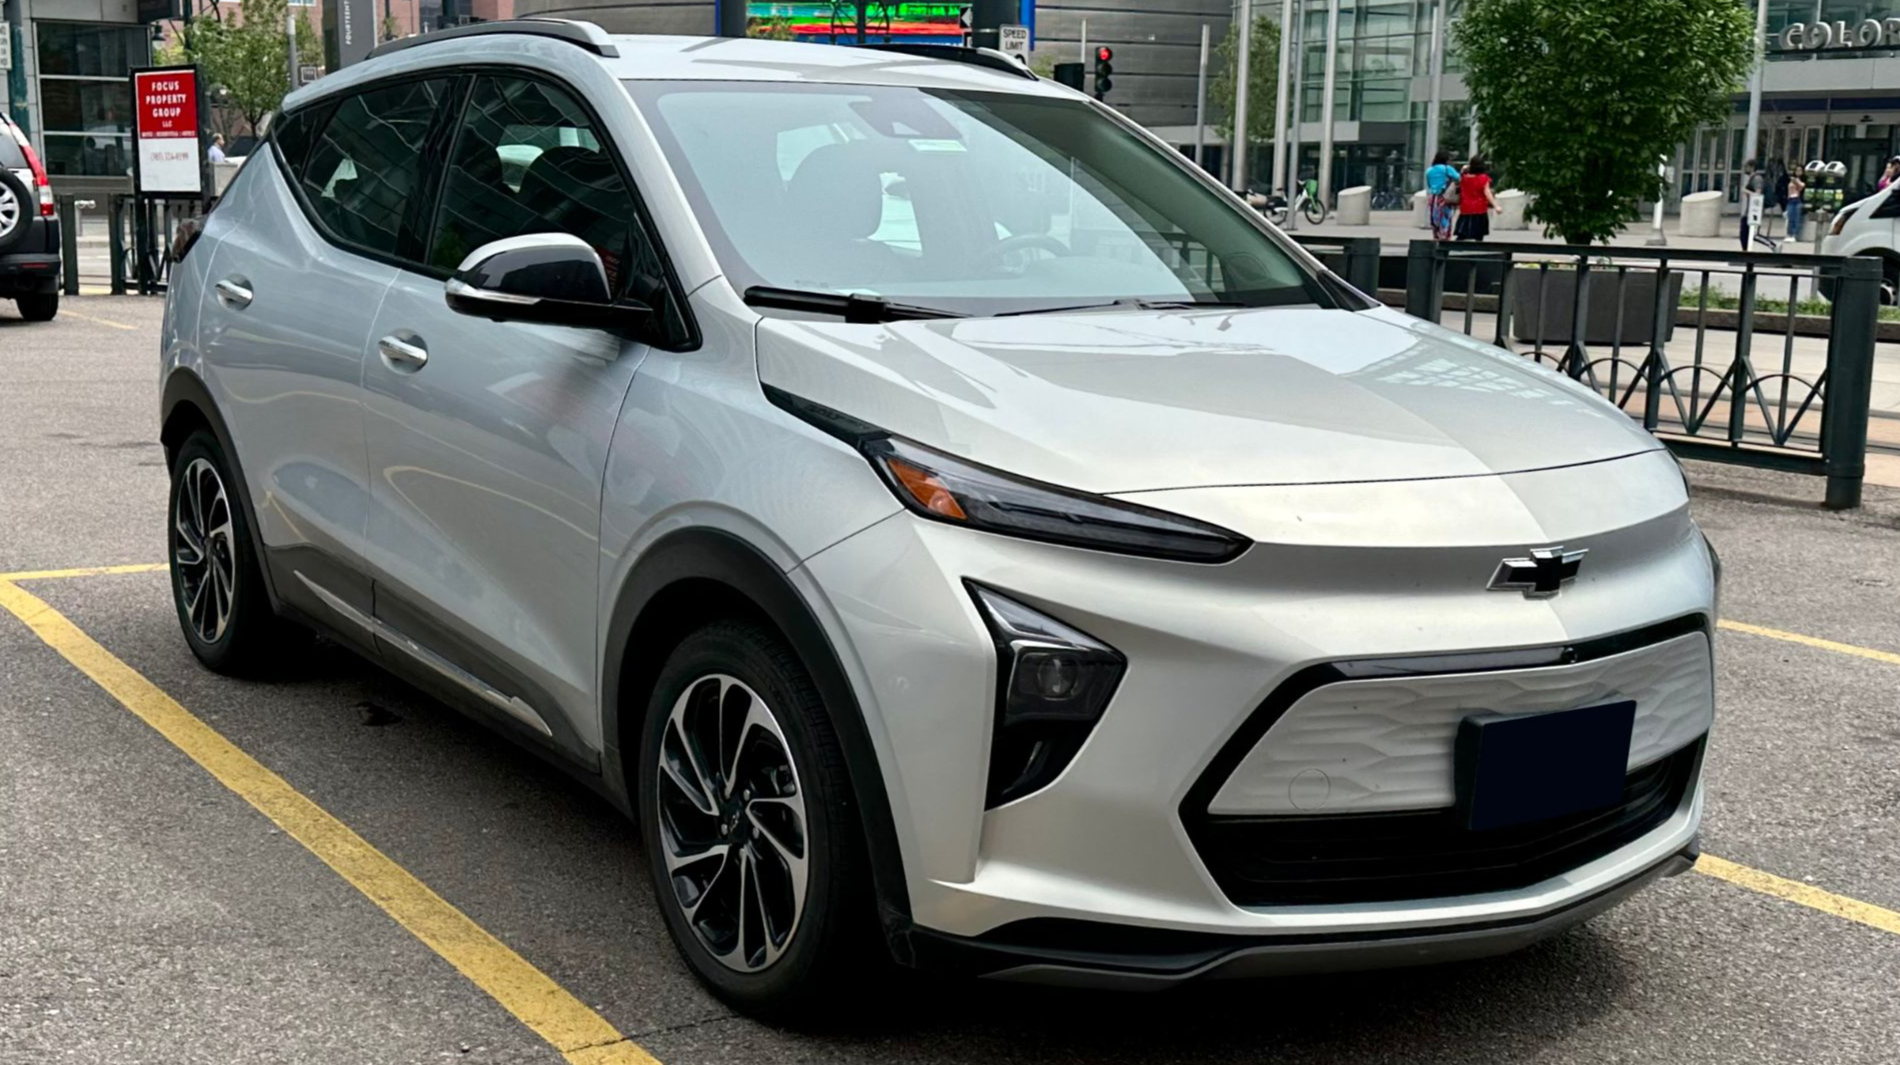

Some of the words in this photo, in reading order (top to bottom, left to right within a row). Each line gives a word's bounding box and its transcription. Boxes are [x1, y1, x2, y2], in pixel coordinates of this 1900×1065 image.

[1003, 29, 1027, 39] SPEED
[1005, 41, 1024, 50] LIMIT
[152, 81, 179, 91] FOCUS
[145, 94, 187, 105] PROPERTY
[152, 107, 181, 118] GROUP
[162, 120, 173, 128] LLC
